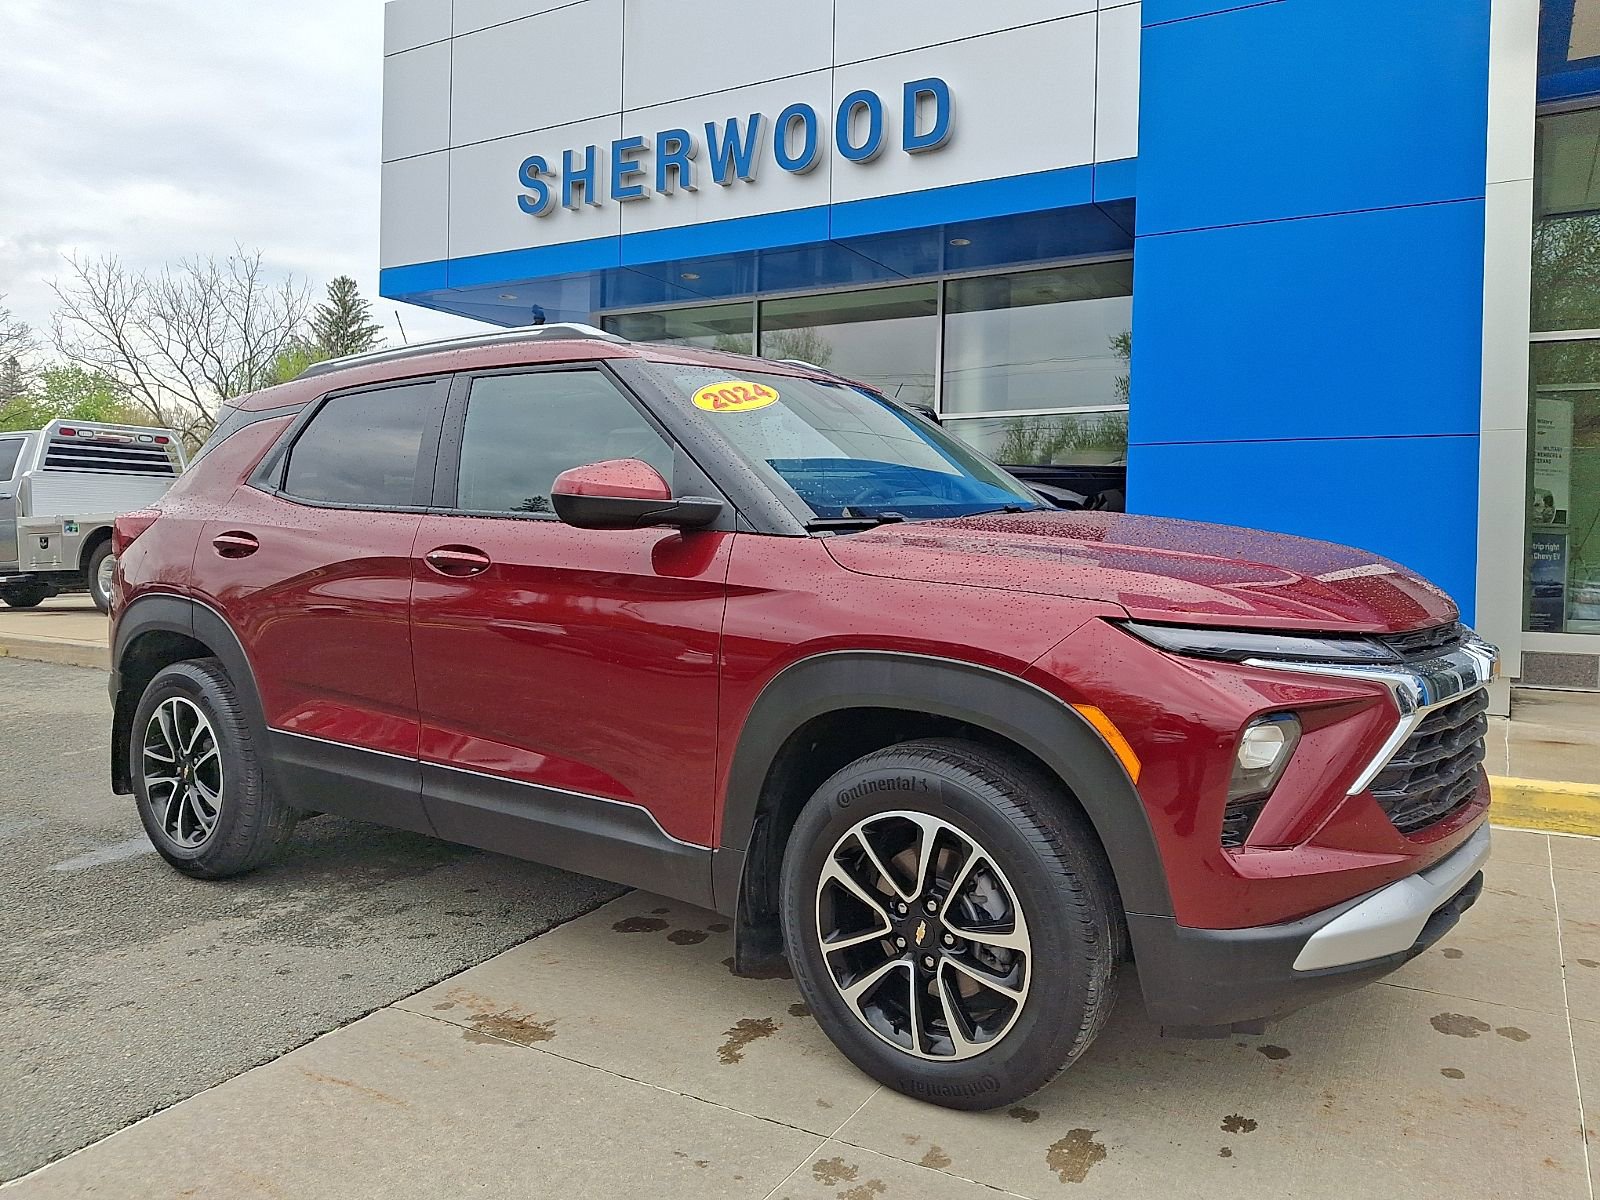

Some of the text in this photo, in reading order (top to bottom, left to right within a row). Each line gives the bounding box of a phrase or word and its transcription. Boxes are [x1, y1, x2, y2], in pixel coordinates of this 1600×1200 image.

[517, 77, 956, 217] SHERWOOD
[702, 384, 772, 409] 2024
[1532, 542, 1560, 552] trip right
[1533, 552, 1561, 561] Chevy EV
[837, 776, 916, 808] Continental
